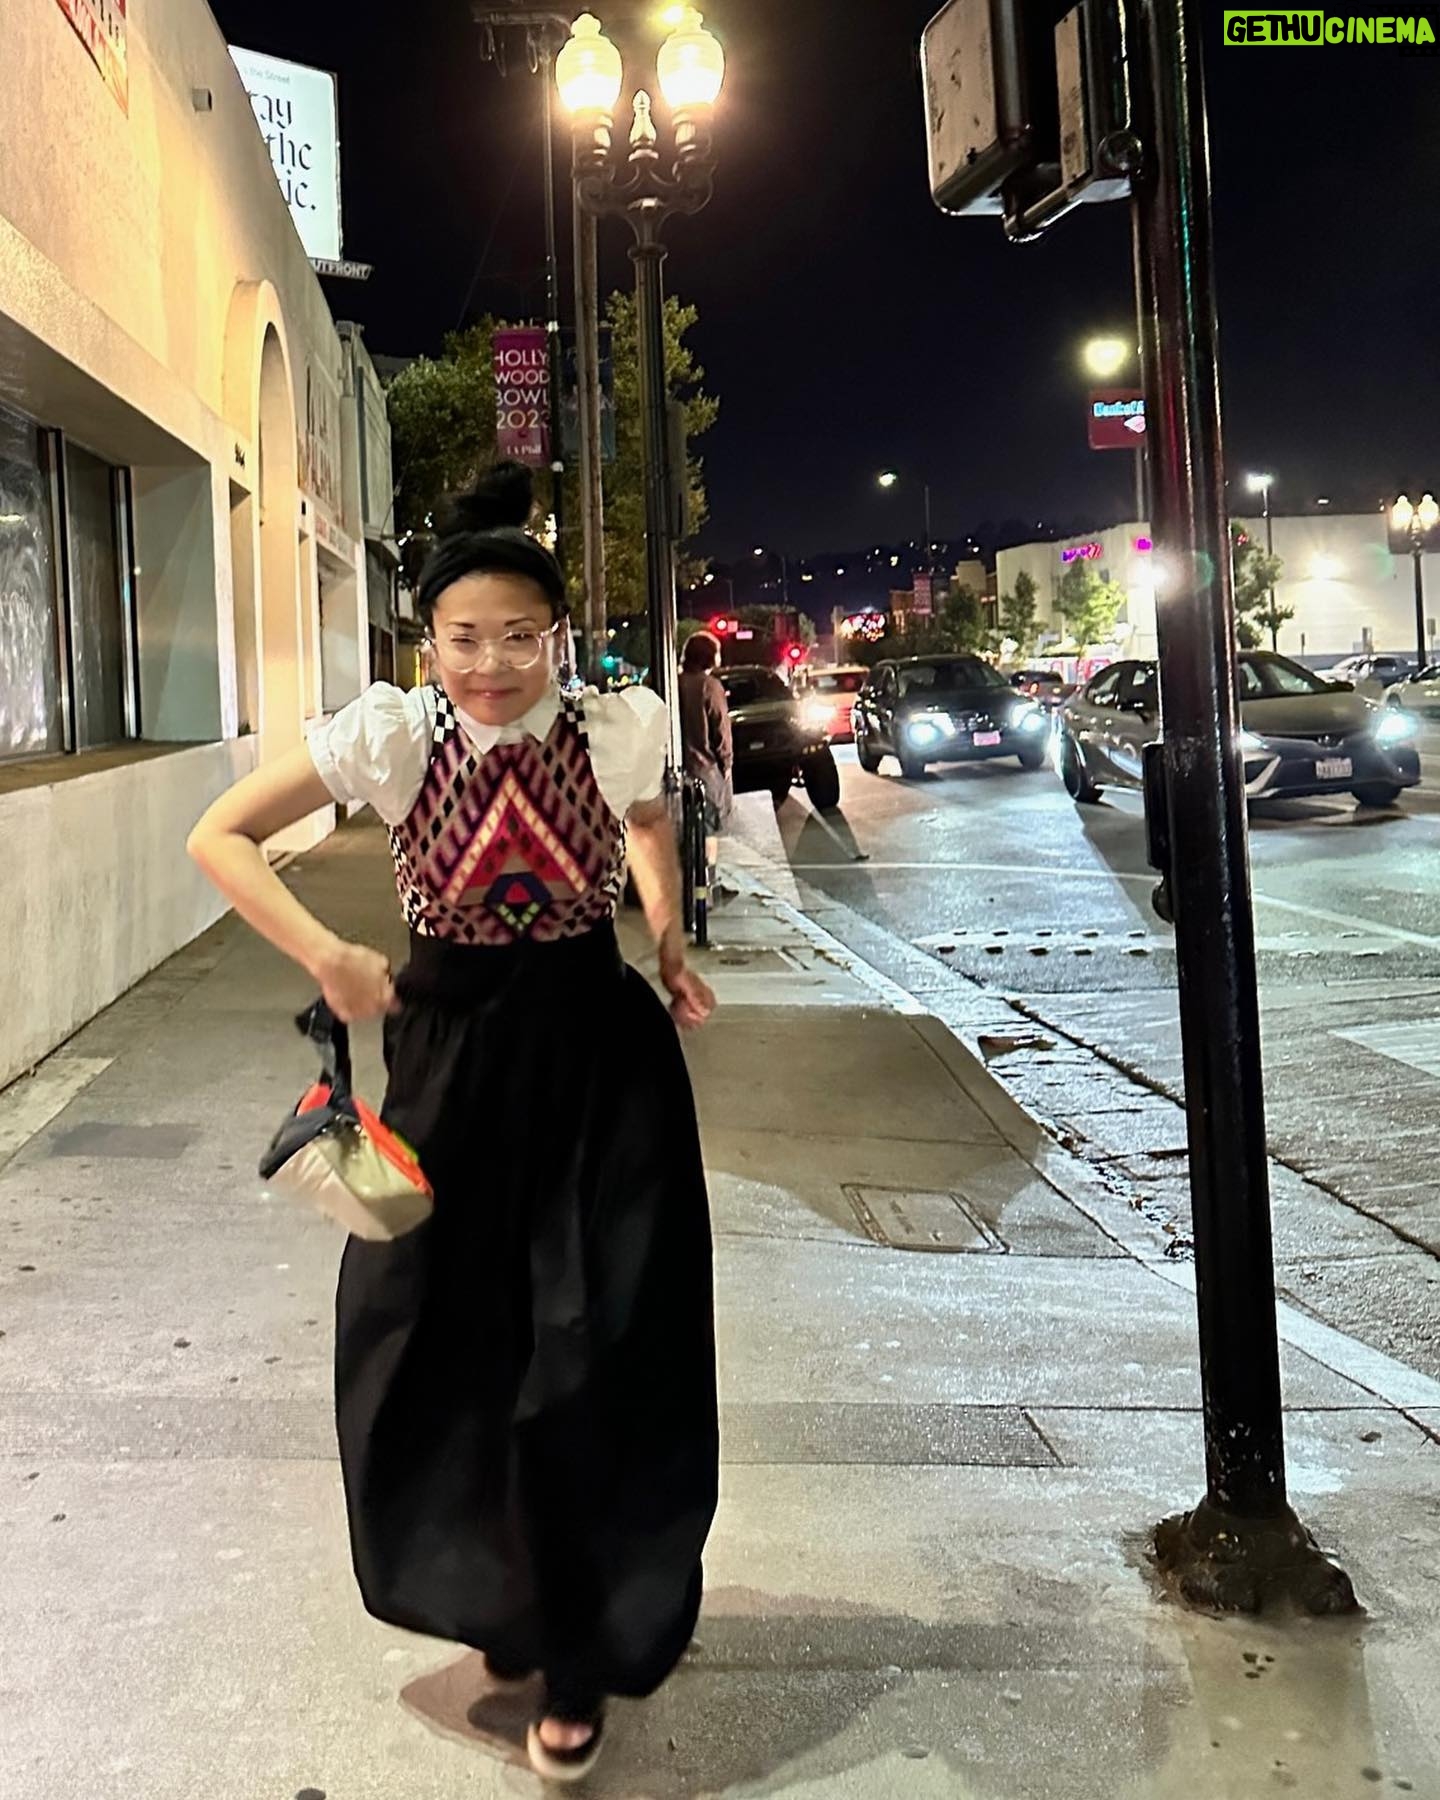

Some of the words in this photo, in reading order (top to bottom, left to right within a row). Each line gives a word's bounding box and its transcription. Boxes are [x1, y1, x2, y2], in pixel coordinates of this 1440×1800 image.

[494, 349, 549, 366] HOLLY
[494, 369, 550, 385] WOOD
[495, 388, 548, 406] BOWL
